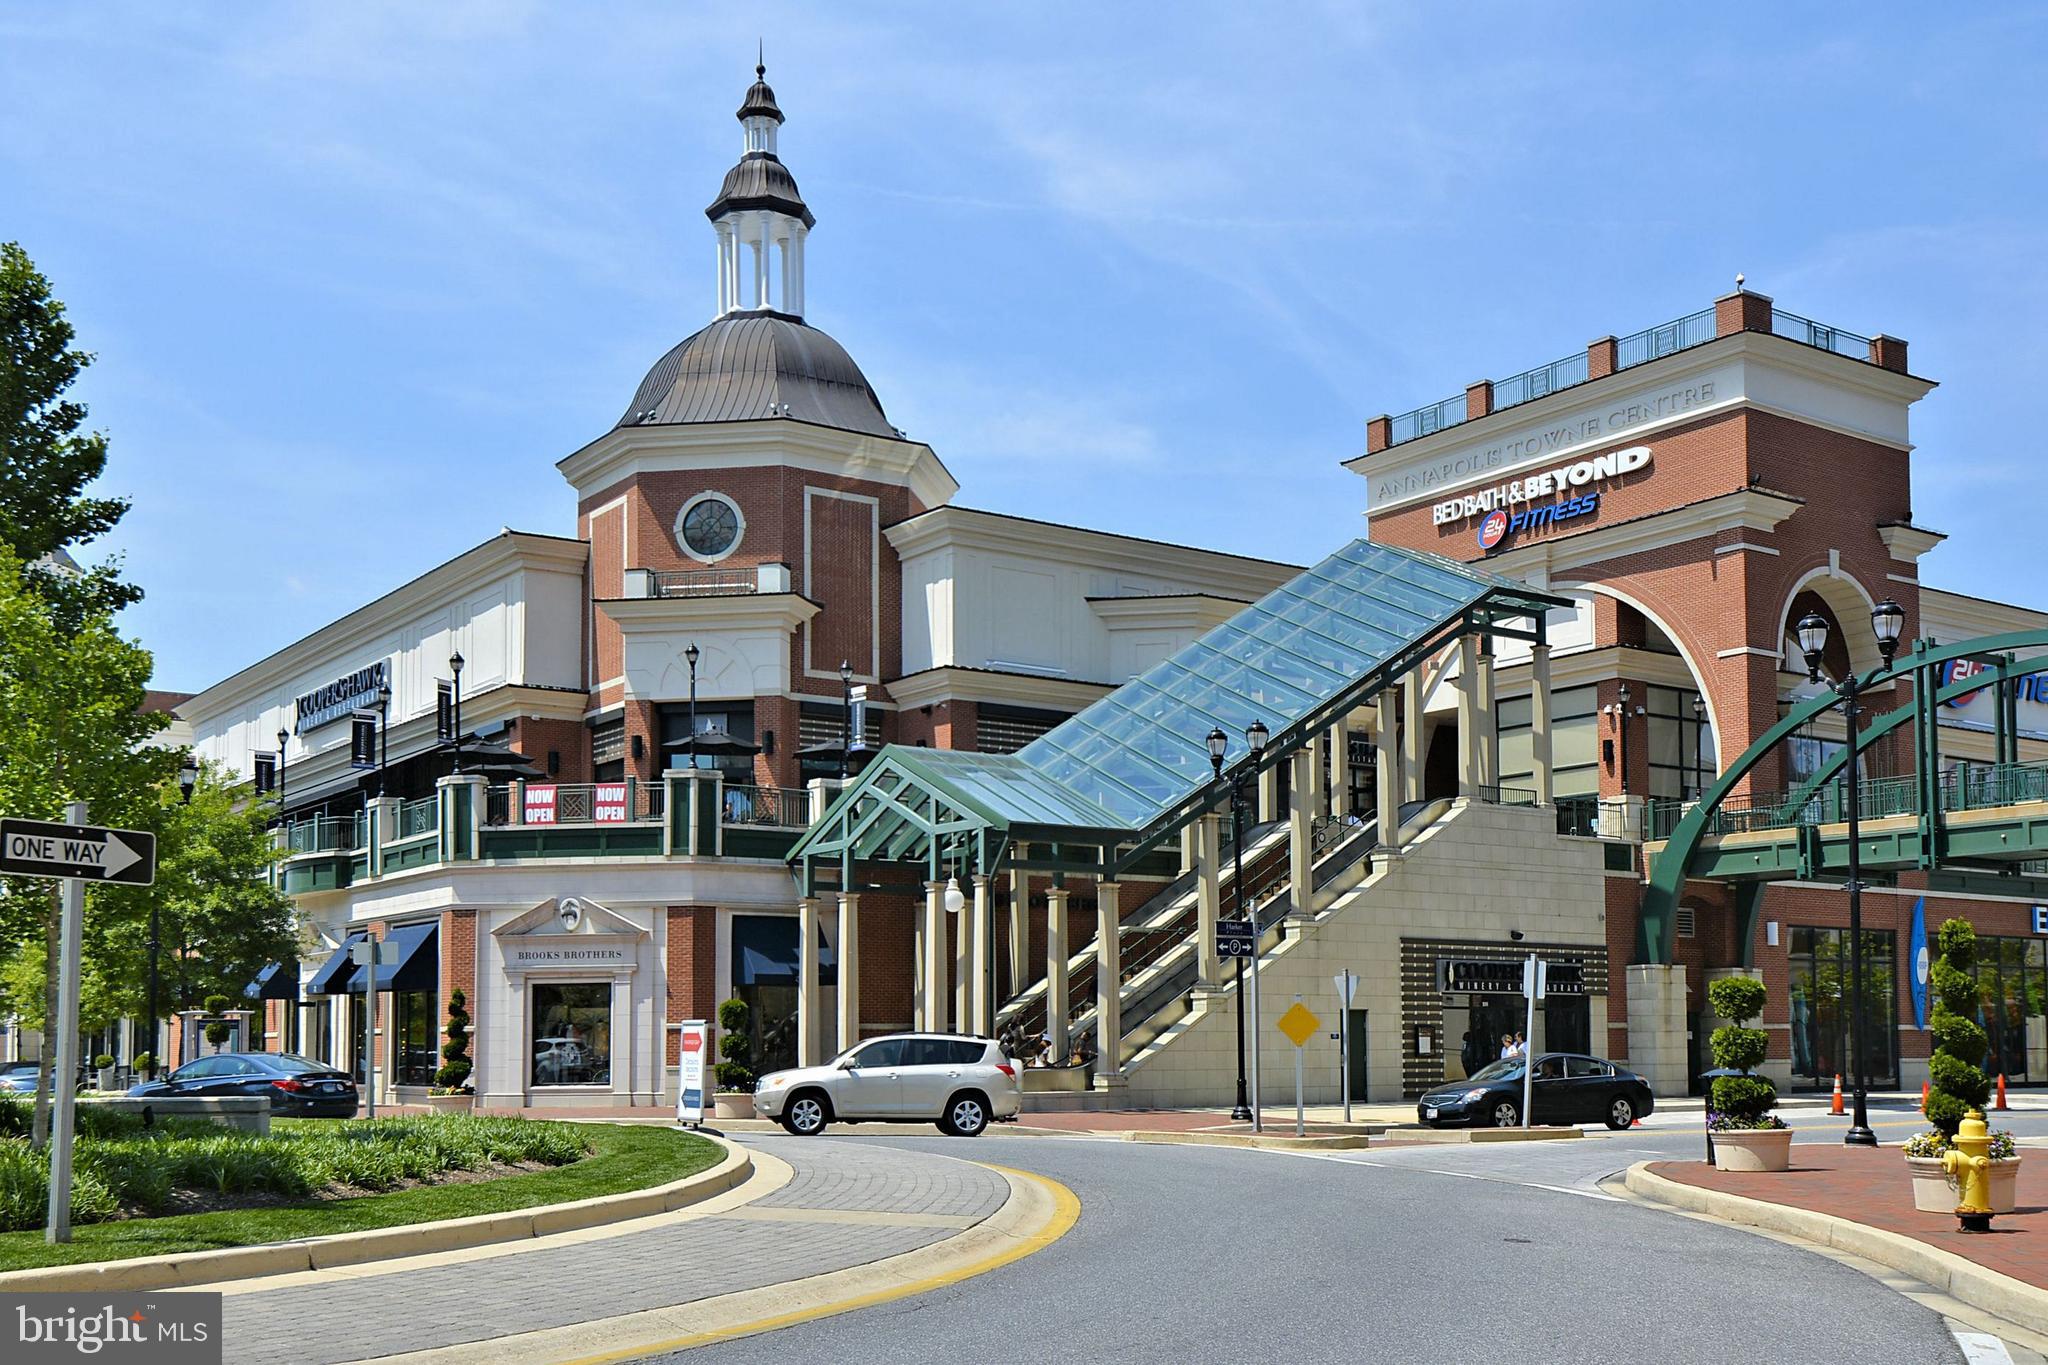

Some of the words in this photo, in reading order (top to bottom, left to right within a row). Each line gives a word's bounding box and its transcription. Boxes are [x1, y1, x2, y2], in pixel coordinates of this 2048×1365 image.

[1378, 447, 1501, 499] ANNAPOLIS
[1506, 417, 1600, 459] TOWNE
[1608, 381, 1715, 428] CENTRE
[1524, 446, 1653, 500] BEYOND
[1483, 518, 1506, 536] 24
[527, 789, 554, 804] NOW
[597, 787, 625, 802] NOW
[526, 808, 554, 823] OPEN
[595, 806, 625, 820] OPEN
[12, 836, 55, 860] ONE
[64, 841, 106, 864] WAY
[518, 951, 560, 960] BROOKS
[564, 950, 622, 960] BROTHERS
[1458, 981, 1499, 991] WINERY
[1519, 983, 1585, 993] RAURANT
